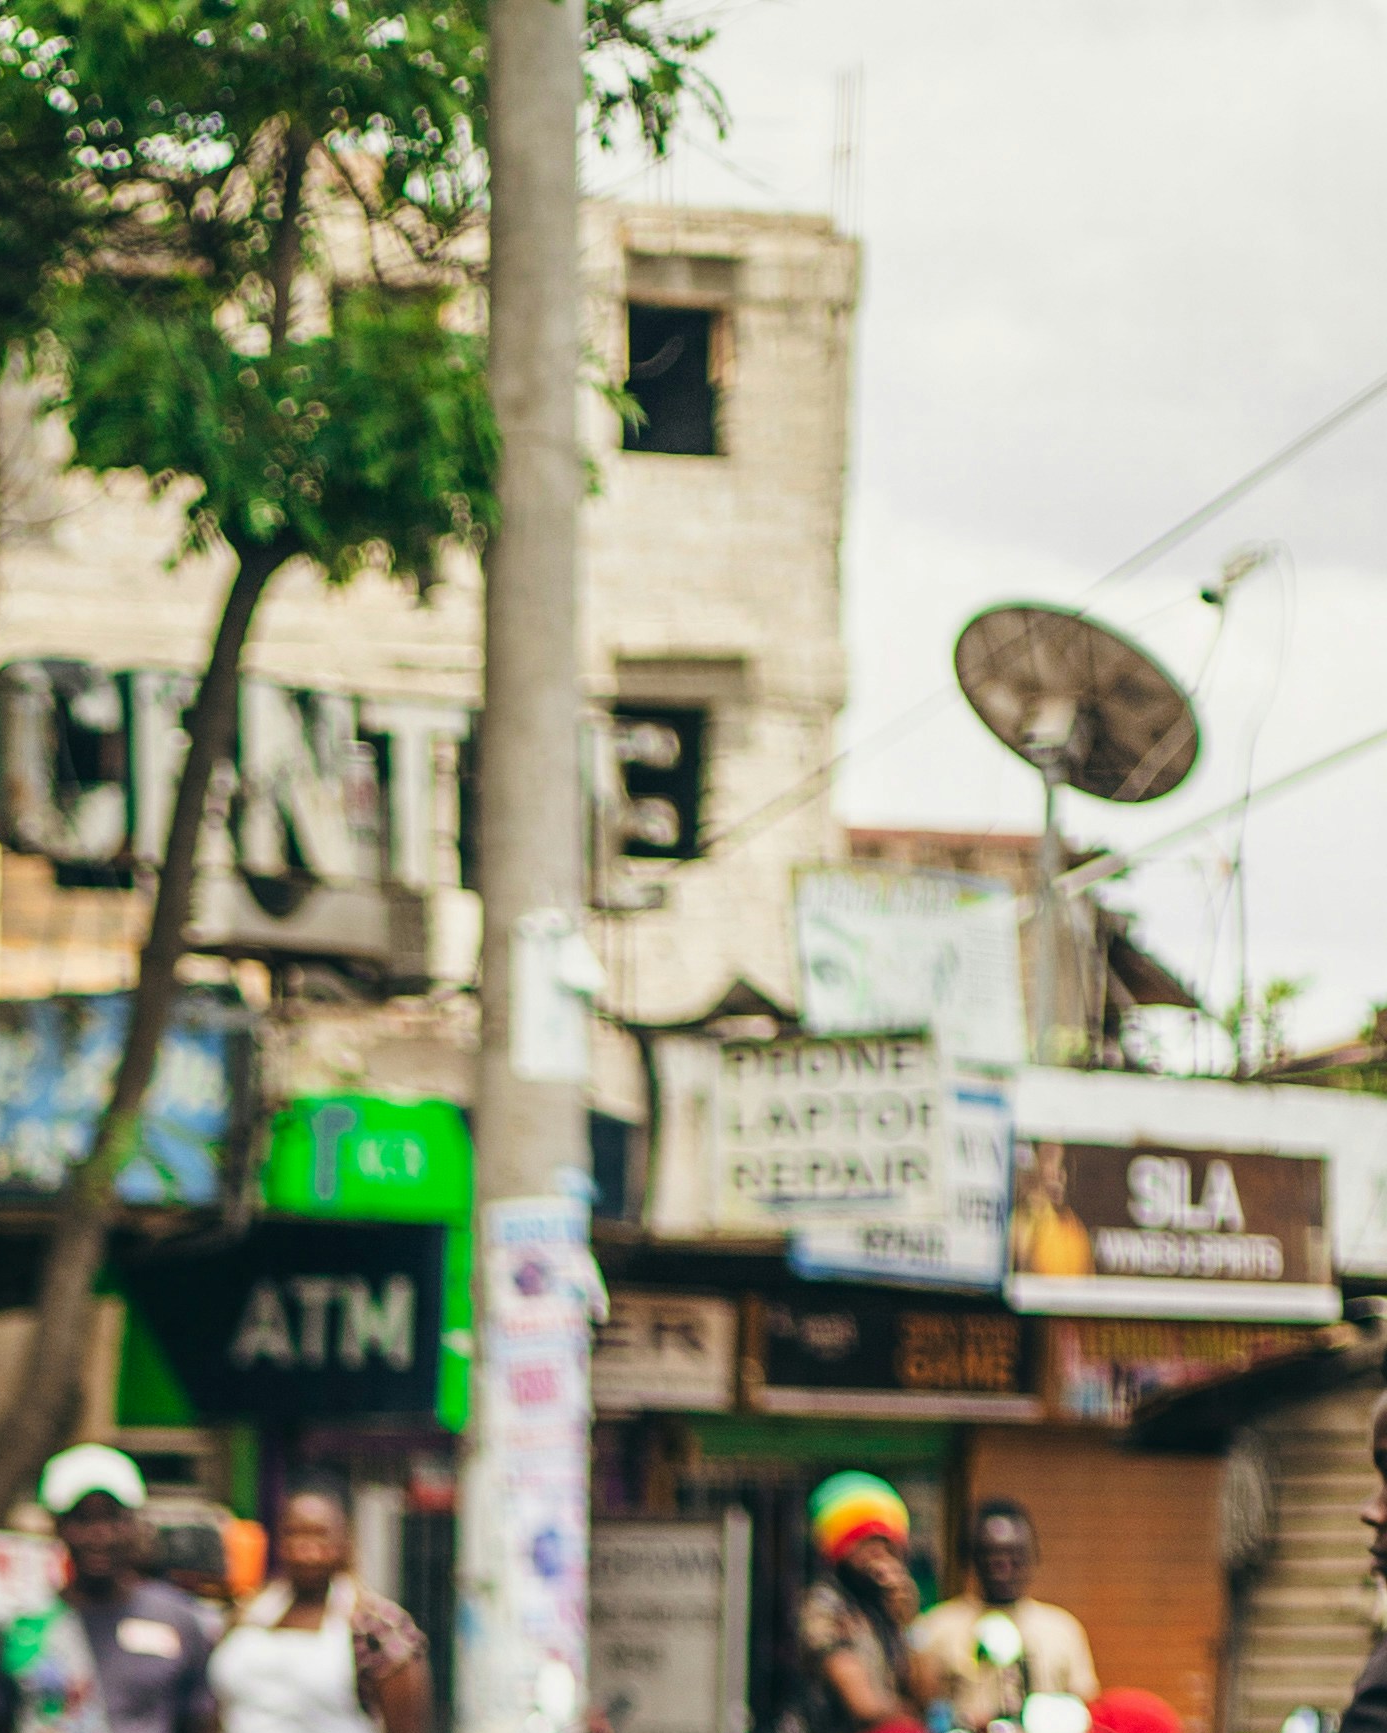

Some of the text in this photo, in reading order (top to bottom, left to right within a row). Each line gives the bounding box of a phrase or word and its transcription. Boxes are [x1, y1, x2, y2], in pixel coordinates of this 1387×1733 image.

[720, 1040, 927, 1086] PHONE
[731, 1148, 932, 1193] REPAIR
[1126, 1153, 1247, 1232] SILA
[230, 1273, 417, 1373] ATM
